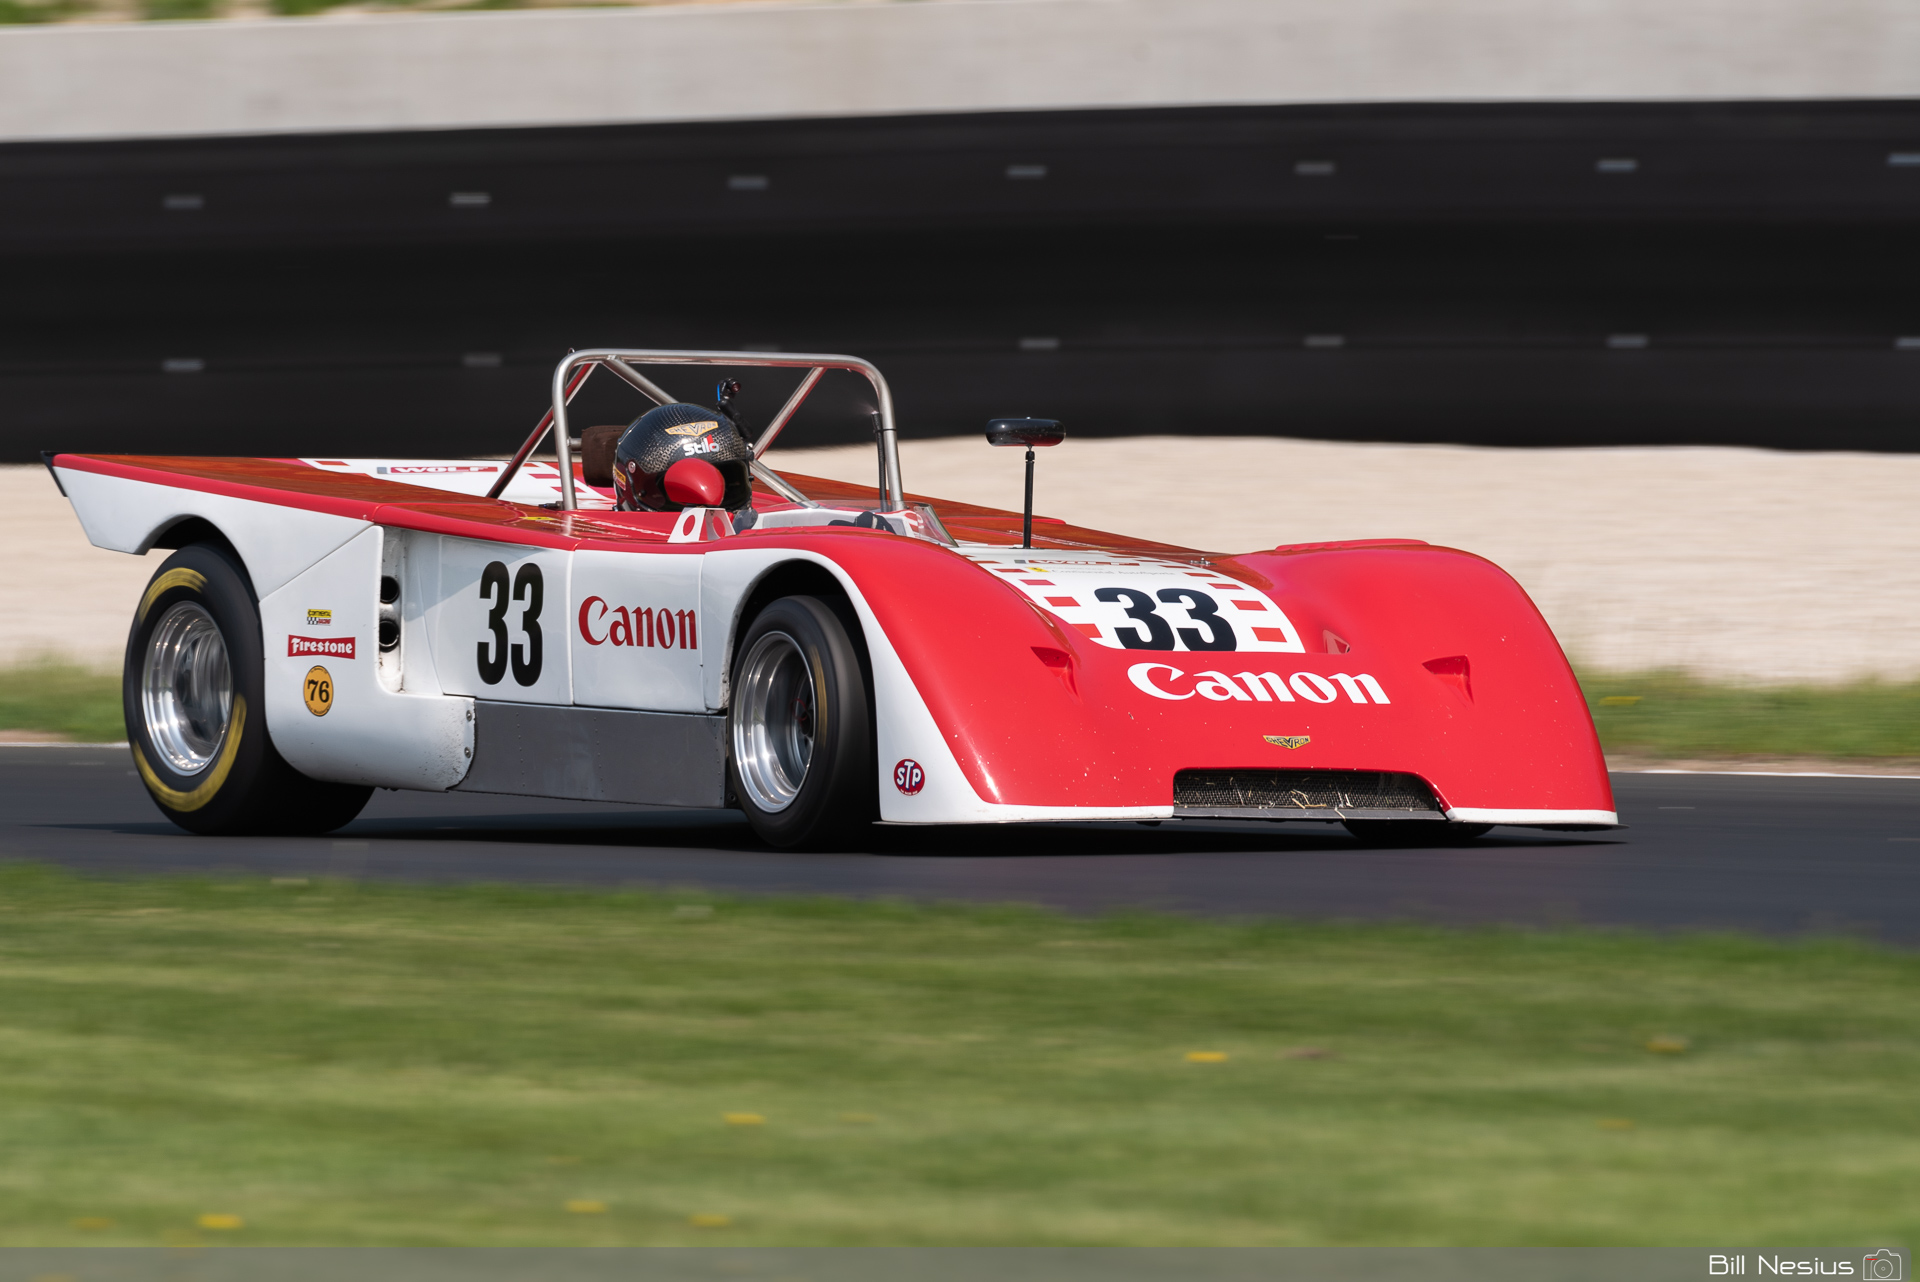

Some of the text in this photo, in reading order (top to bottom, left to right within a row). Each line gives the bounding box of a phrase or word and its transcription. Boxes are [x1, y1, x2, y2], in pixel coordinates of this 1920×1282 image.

[667, 421, 717, 435] CHEVRON
[683, 434, 720, 457] Stilo
[477, 560, 544, 687] 33
[578, 595, 698, 650] Canon
[1094, 587, 1237, 652] 33
[290, 637, 353, 654] Firestone
[307, 679, 330, 703] 76
[1127, 662, 1392, 705] Canon
[1265, 736, 1309, 749] CHEVRON
[896, 760, 922, 790] STP
